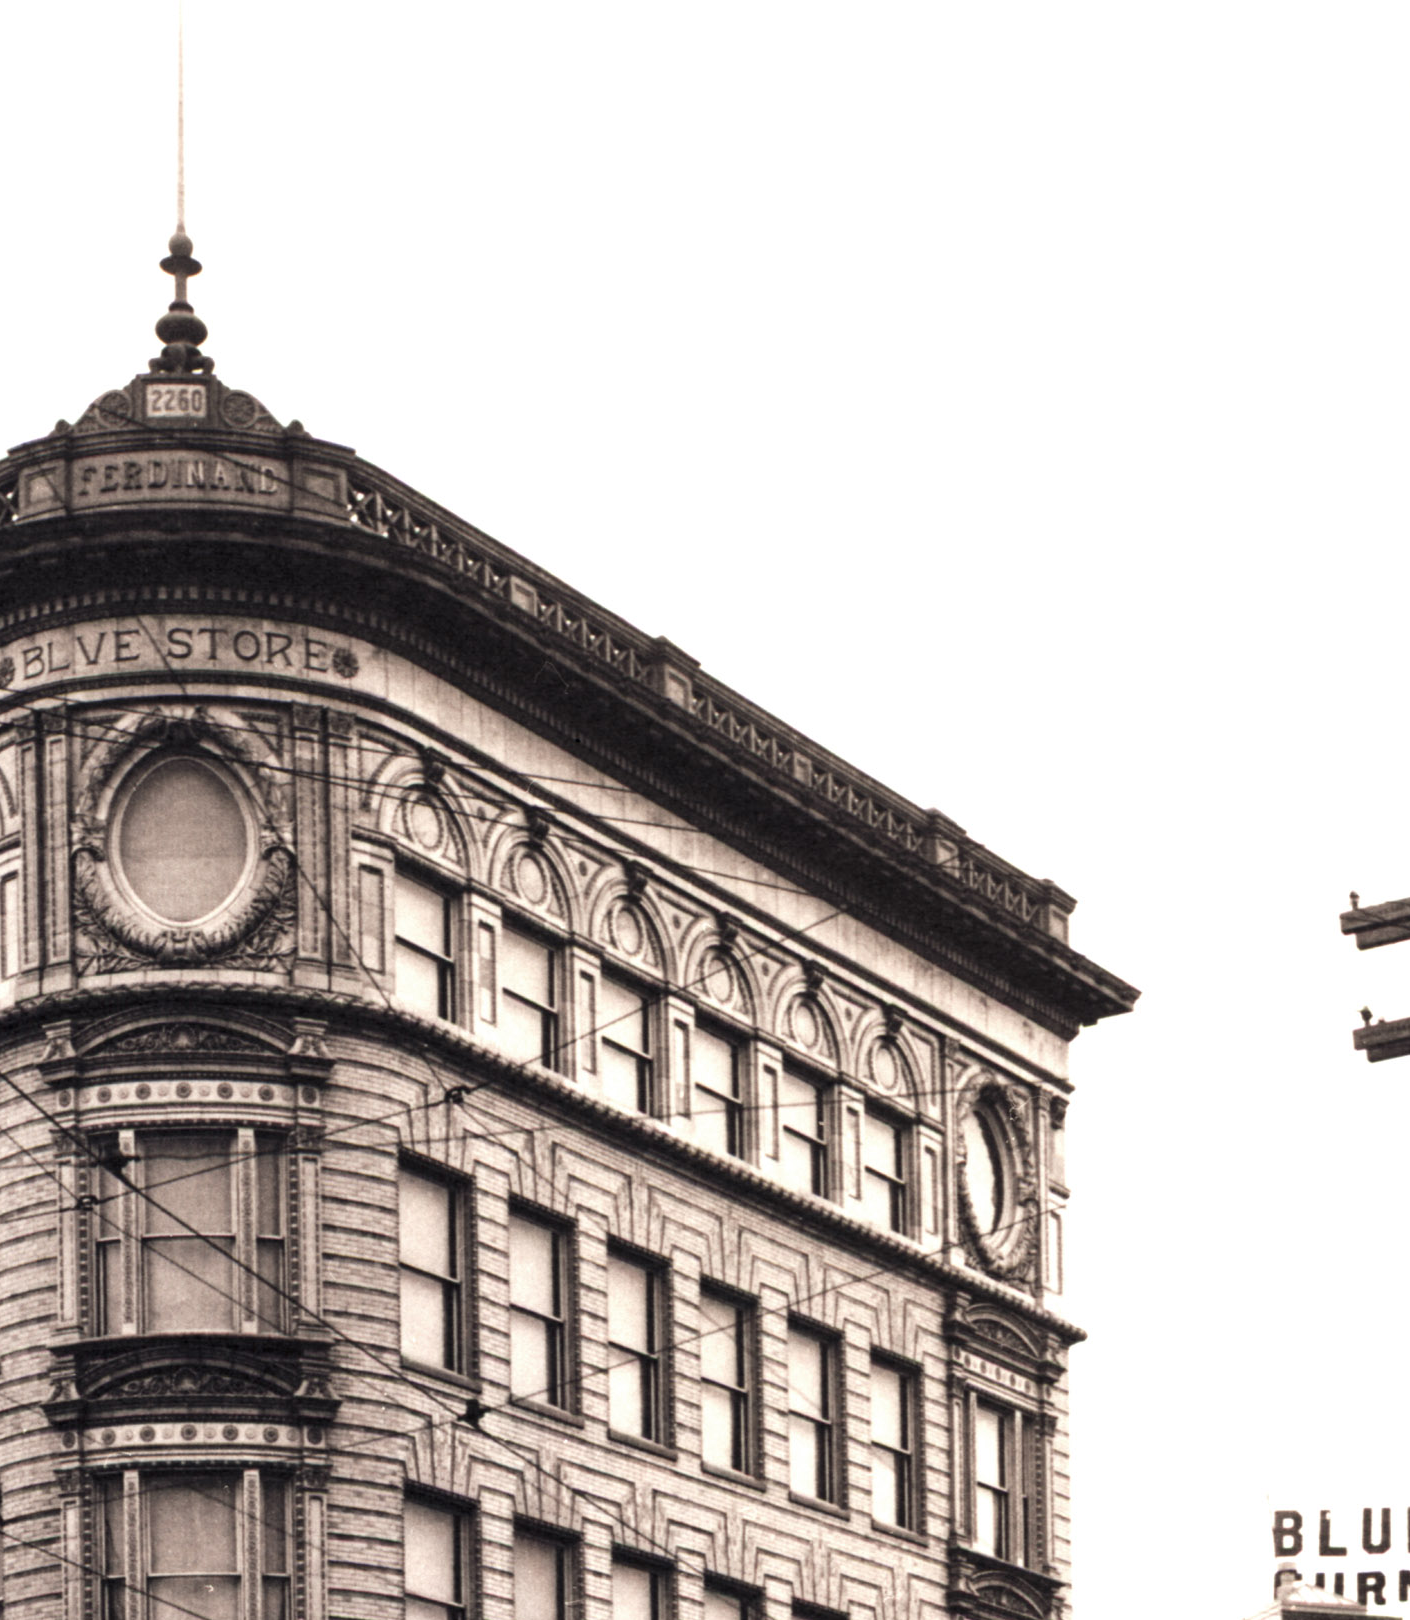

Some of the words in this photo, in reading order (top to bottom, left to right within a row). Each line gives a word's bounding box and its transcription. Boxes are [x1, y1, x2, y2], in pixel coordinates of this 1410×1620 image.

[149, 386, 204, 414] 2260
[77, 459, 279, 496] FERDINAND
[166, 627, 332, 673] STORE
